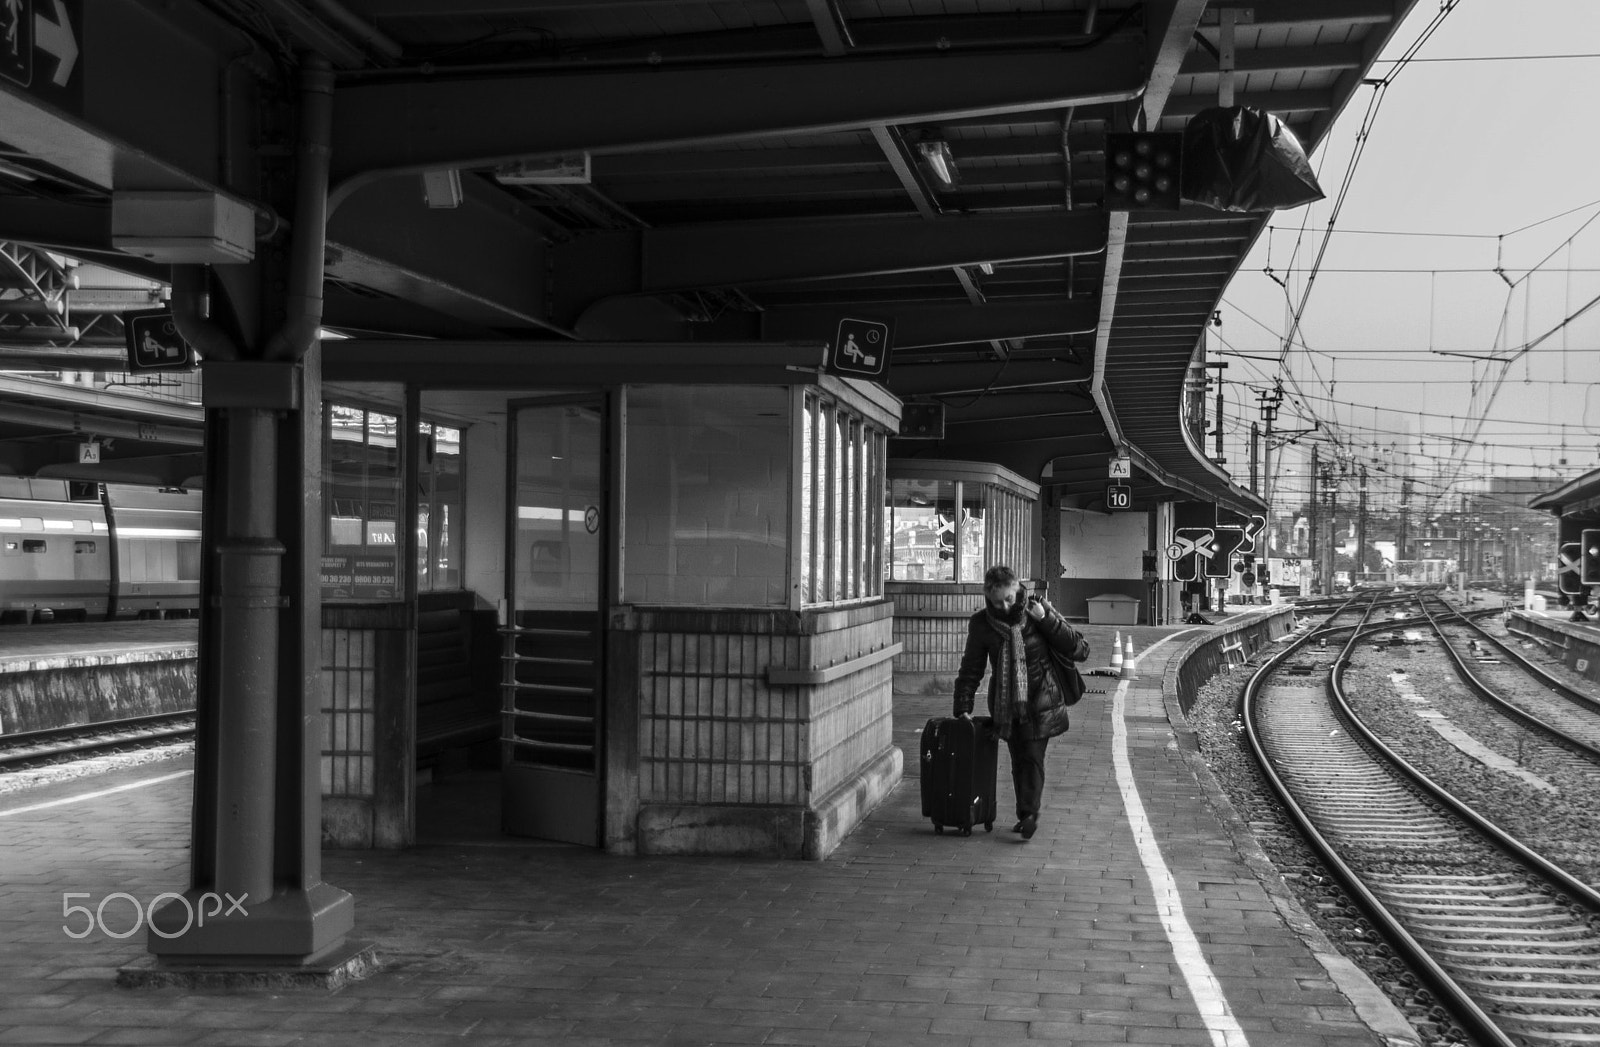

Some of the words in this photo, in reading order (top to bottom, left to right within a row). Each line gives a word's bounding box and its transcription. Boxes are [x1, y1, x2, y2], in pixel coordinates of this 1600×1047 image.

[1113, 463, 1126, 474] A3
[80, 482, 89, 495] 7
[1111, 493, 1127, 506] 10
